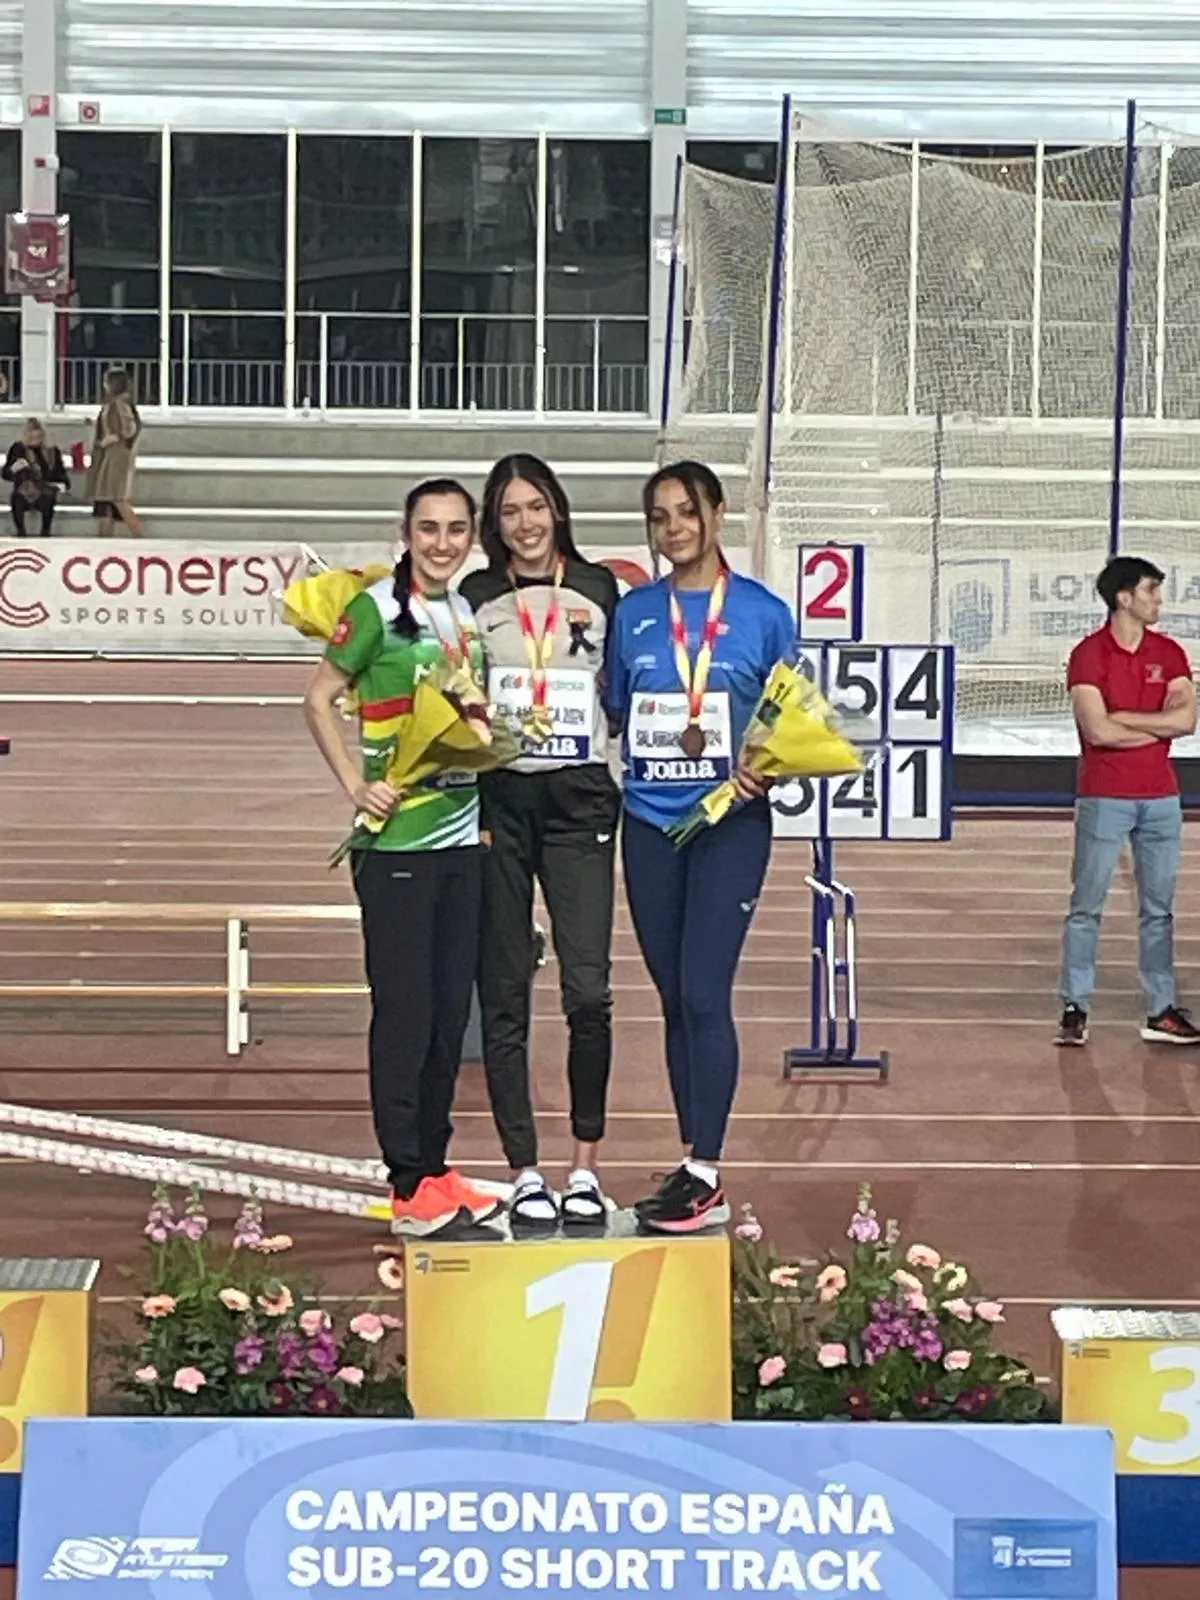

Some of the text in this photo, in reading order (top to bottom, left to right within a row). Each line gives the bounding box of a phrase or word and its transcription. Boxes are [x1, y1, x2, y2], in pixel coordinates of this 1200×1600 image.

[804, 551, 849, 619] 2
[60, 607, 286, 627] SPORTS SOLUTI
[1126, 1345, 1200, 1465] 3
[285, 1483, 895, 1535] CAMPEONATO ESPAÑA
[287, 1545, 882, 1591] SUB-20 SHORT TRACK
